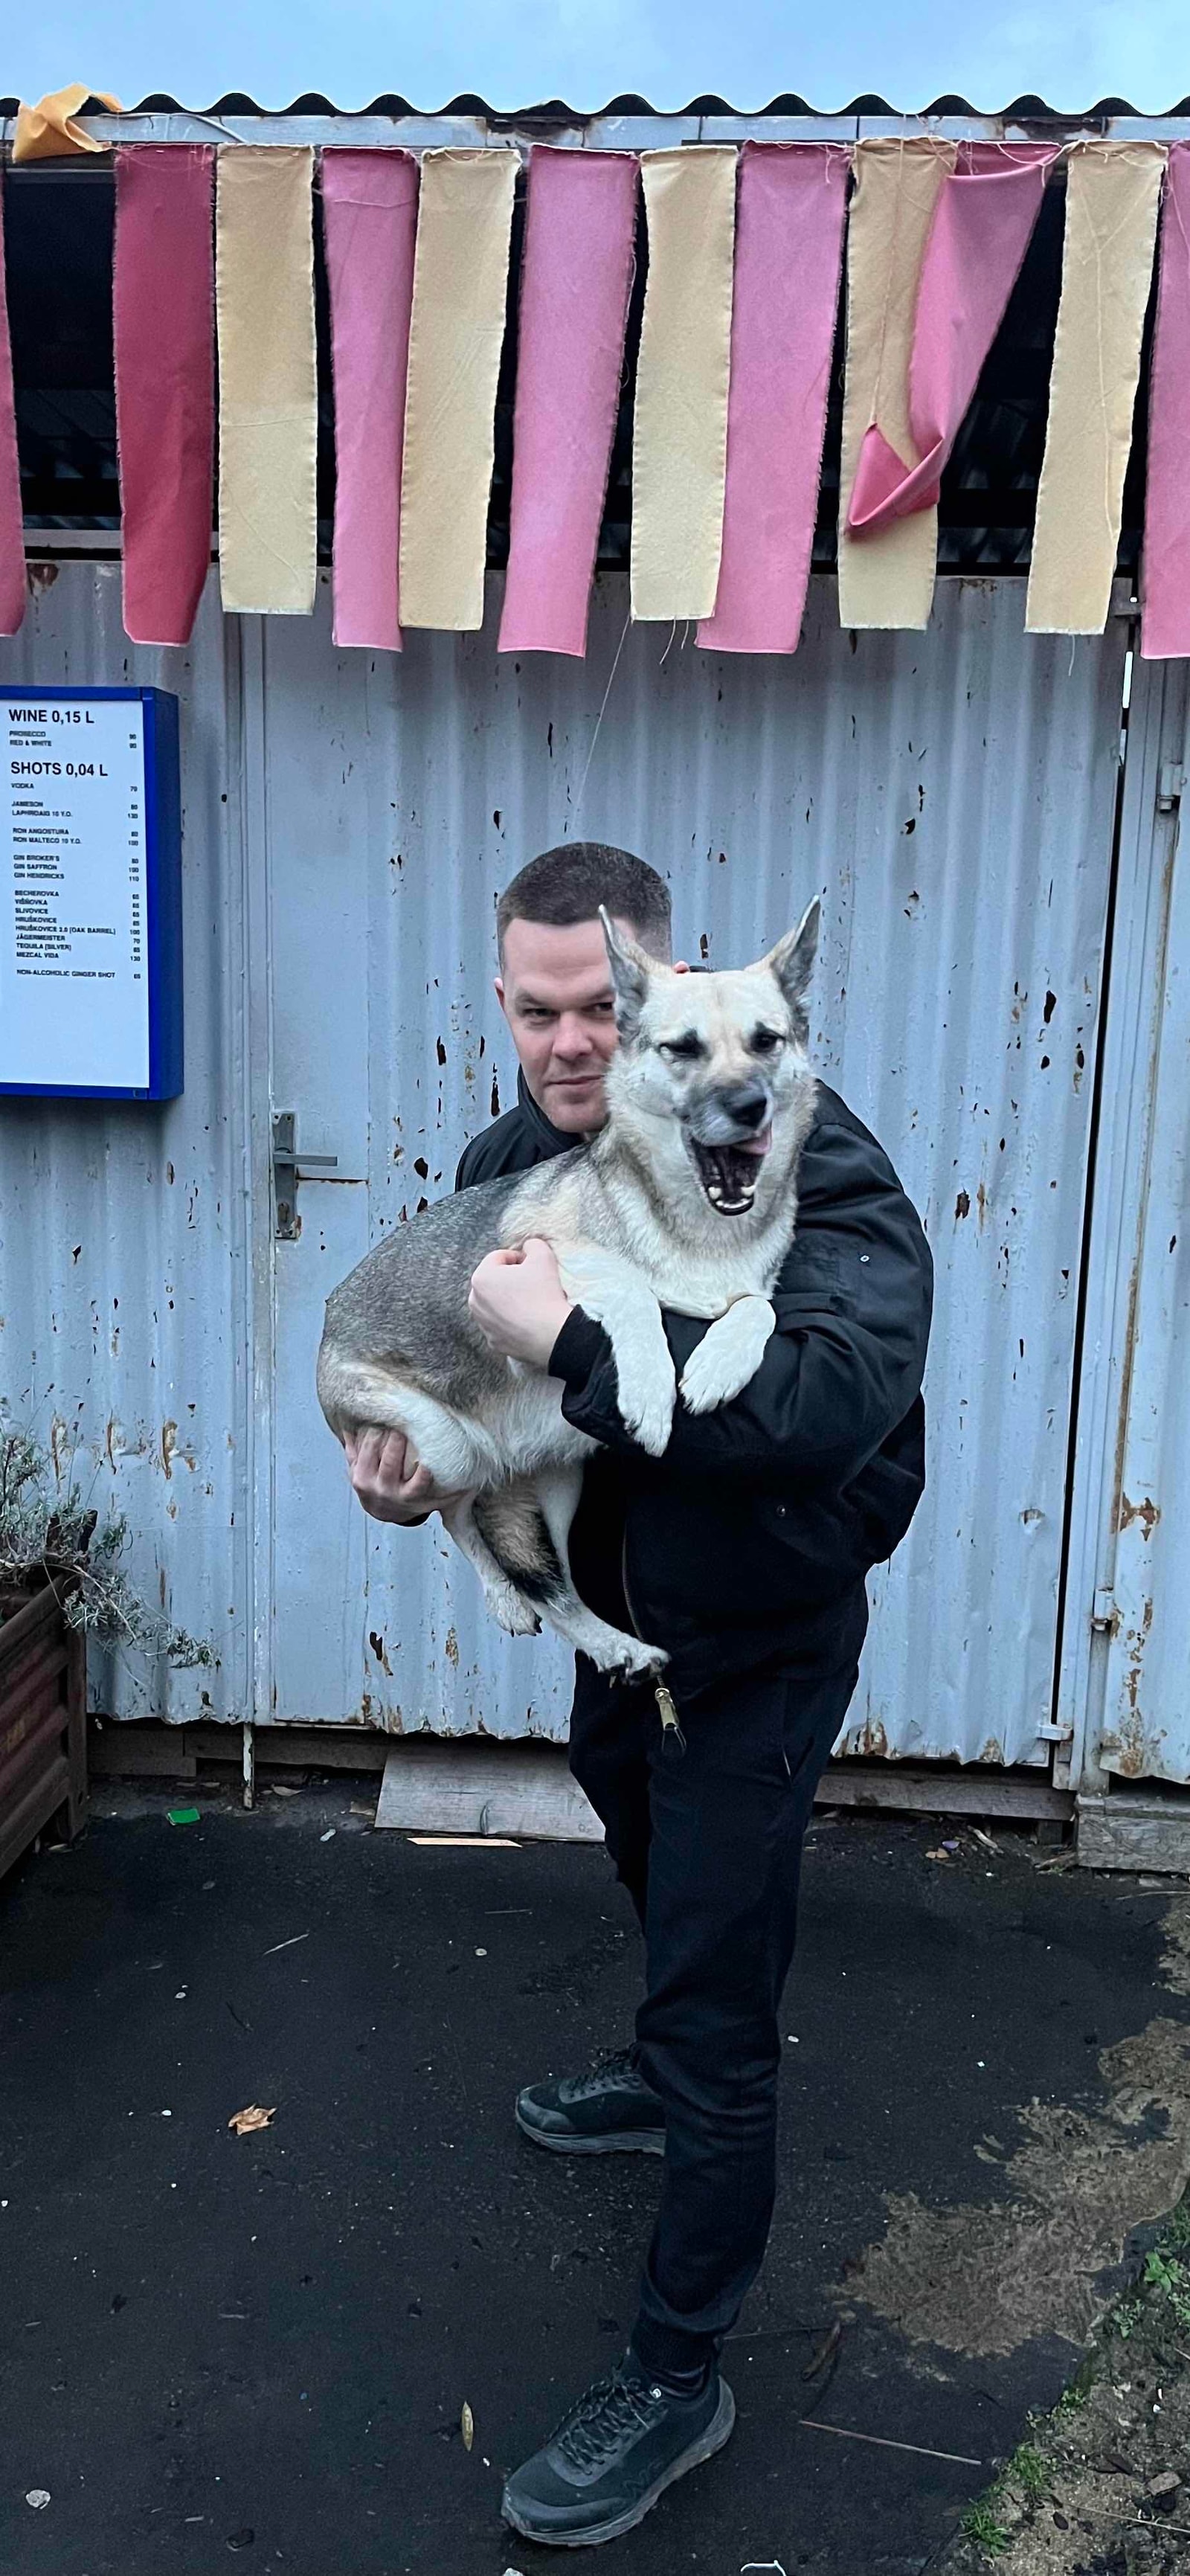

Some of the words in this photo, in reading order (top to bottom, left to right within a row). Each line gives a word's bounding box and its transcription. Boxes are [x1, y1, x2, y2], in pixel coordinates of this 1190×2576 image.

[9, 709, 47, 722] WINE
[52, 711, 80, 725] 0,15
[86, 712, 94, 723] L
[11, 762, 61, 775] SHOTS
[66, 763, 94, 777] 0,04
[100, 765, 108, 776] L
